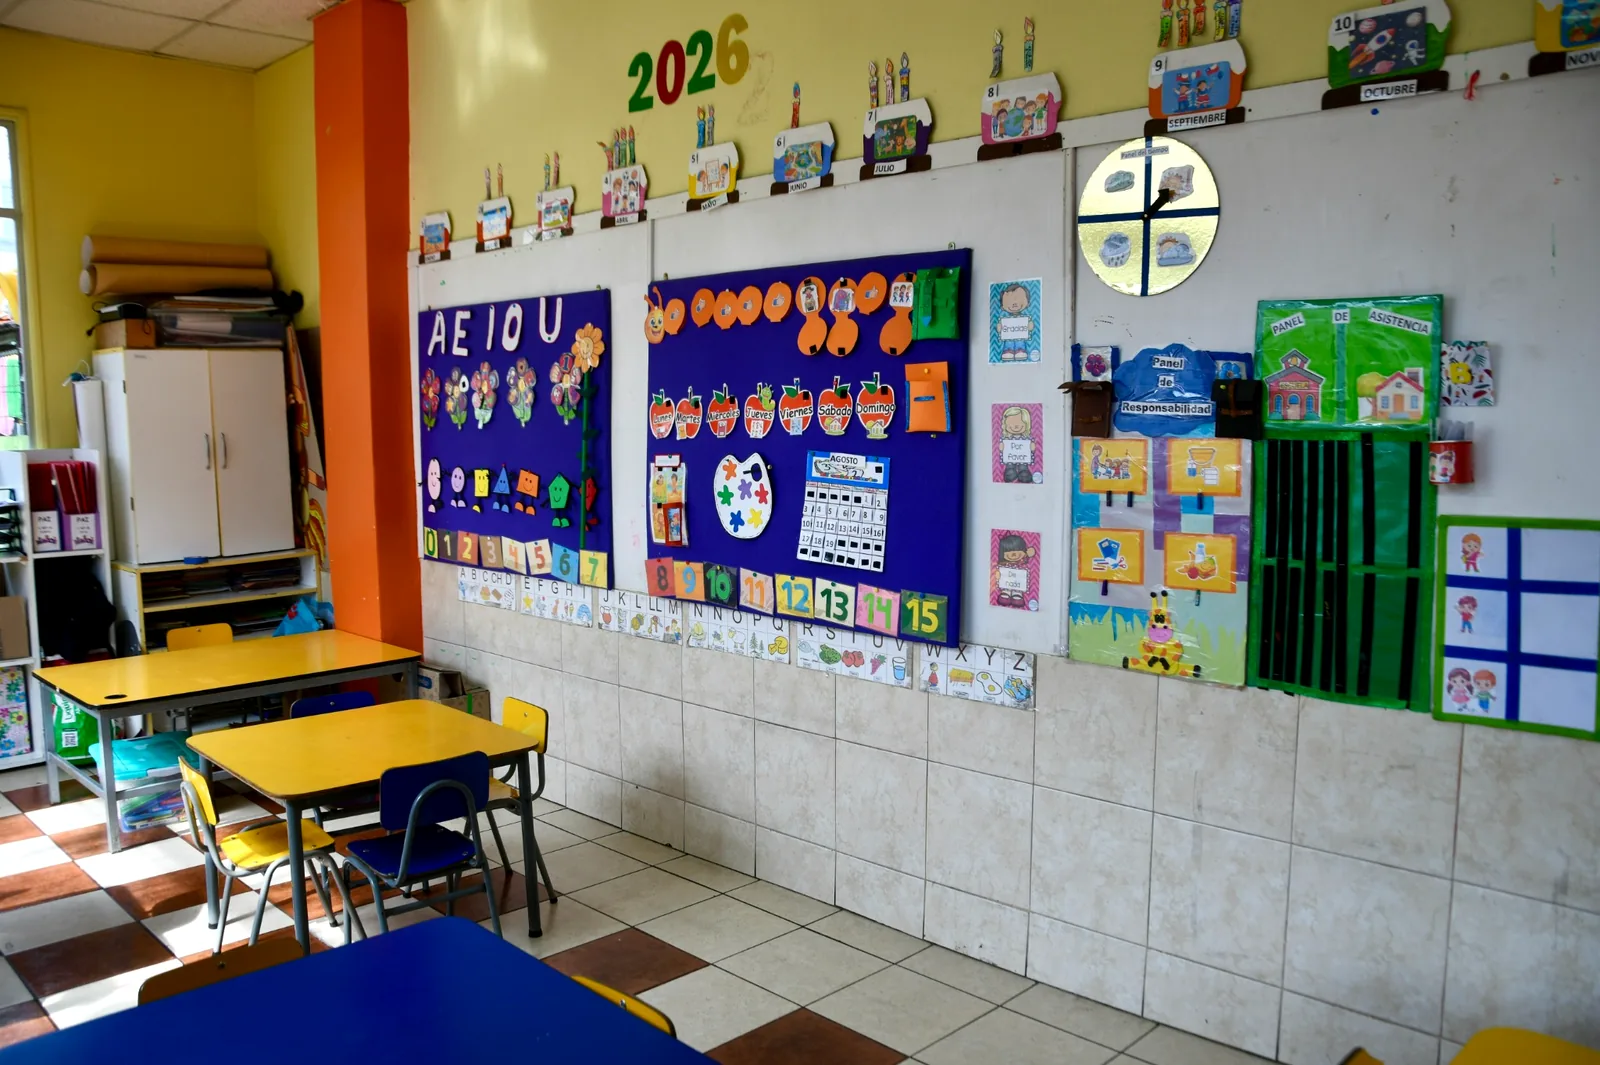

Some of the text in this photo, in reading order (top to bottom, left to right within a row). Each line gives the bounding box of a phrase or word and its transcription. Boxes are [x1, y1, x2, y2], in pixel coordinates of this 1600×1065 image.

[1334, 16, 1351, 31] 10
[628, 13, 750, 113] 2026
[1155, 60, 1162, 72] 9
[987, 86, 994, 98] 8
[1364, 83, 1416, 99] OCTUBRE
[868, 111, 873, 121] 7
[1168, 111, 1226, 128] SEPTIEMBRE
[776, 137, 782, 147] 6
[691, 154, 696, 163] 5
[1121, 151, 1136, 159] Panel
[874, 164, 895, 173] JULIO
[789, 181, 807, 193] JUNIO
[702, 199, 717, 211] MAYO
[616, 216, 629, 224] ABRIL
[1272, 309, 1429, 335] PANEL DE ASISTENCIA
[1003, 325, 1027, 333] Gracias
[1152, 358, 1184, 369] Panel
[1451, 362, 1472, 385] B
[1159, 376, 1173, 387] de
[707, 407, 740, 421] Miércoles
[746, 407, 772, 419] Jueves
[780, 406, 813, 419] Viernes
[819, 404, 852, 416] Sábado
[856, 401, 896, 415] Domingo
[1122, 402, 1212, 415] Responsabilidad
[653, 413, 672, 423] Lunes
[676, 412, 701, 424] Martes
[830, 455, 858, 465] AGOSTO
[802, 520, 810, 528] 10
[827, 523, 835, 531] 12
[849, 525, 857, 533] 14
[873, 529, 881, 537] 16
[814, 537, 822, 545] 18
[425, 530, 599, 581] 0 1 2 3 4 5 6 7
[460, 568, 512, 585] A B C CH D
[525, 577, 531, 589] E
[538, 579, 543, 591] F
[551, 582, 559, 594] G
[566, 583, 573, 596] H
[618, 592, 626, 606] K
[635, 595, 642, 608] L
[649, 598, 662, 613] LL
[668, 601, 678, 615] M
[657, 566, 939, 633] 8 9 10 11 12 13 14 15
[694, 603, 703, 617] N
[732, 610, 742, 624] O
[753, 613, 762, 626] P
[772, 617, 784, 631] Q
[803, 622, 814, 636] R
[826, 625, 836, 640] S
[926, 643, 1026, 671] W X Y Z
